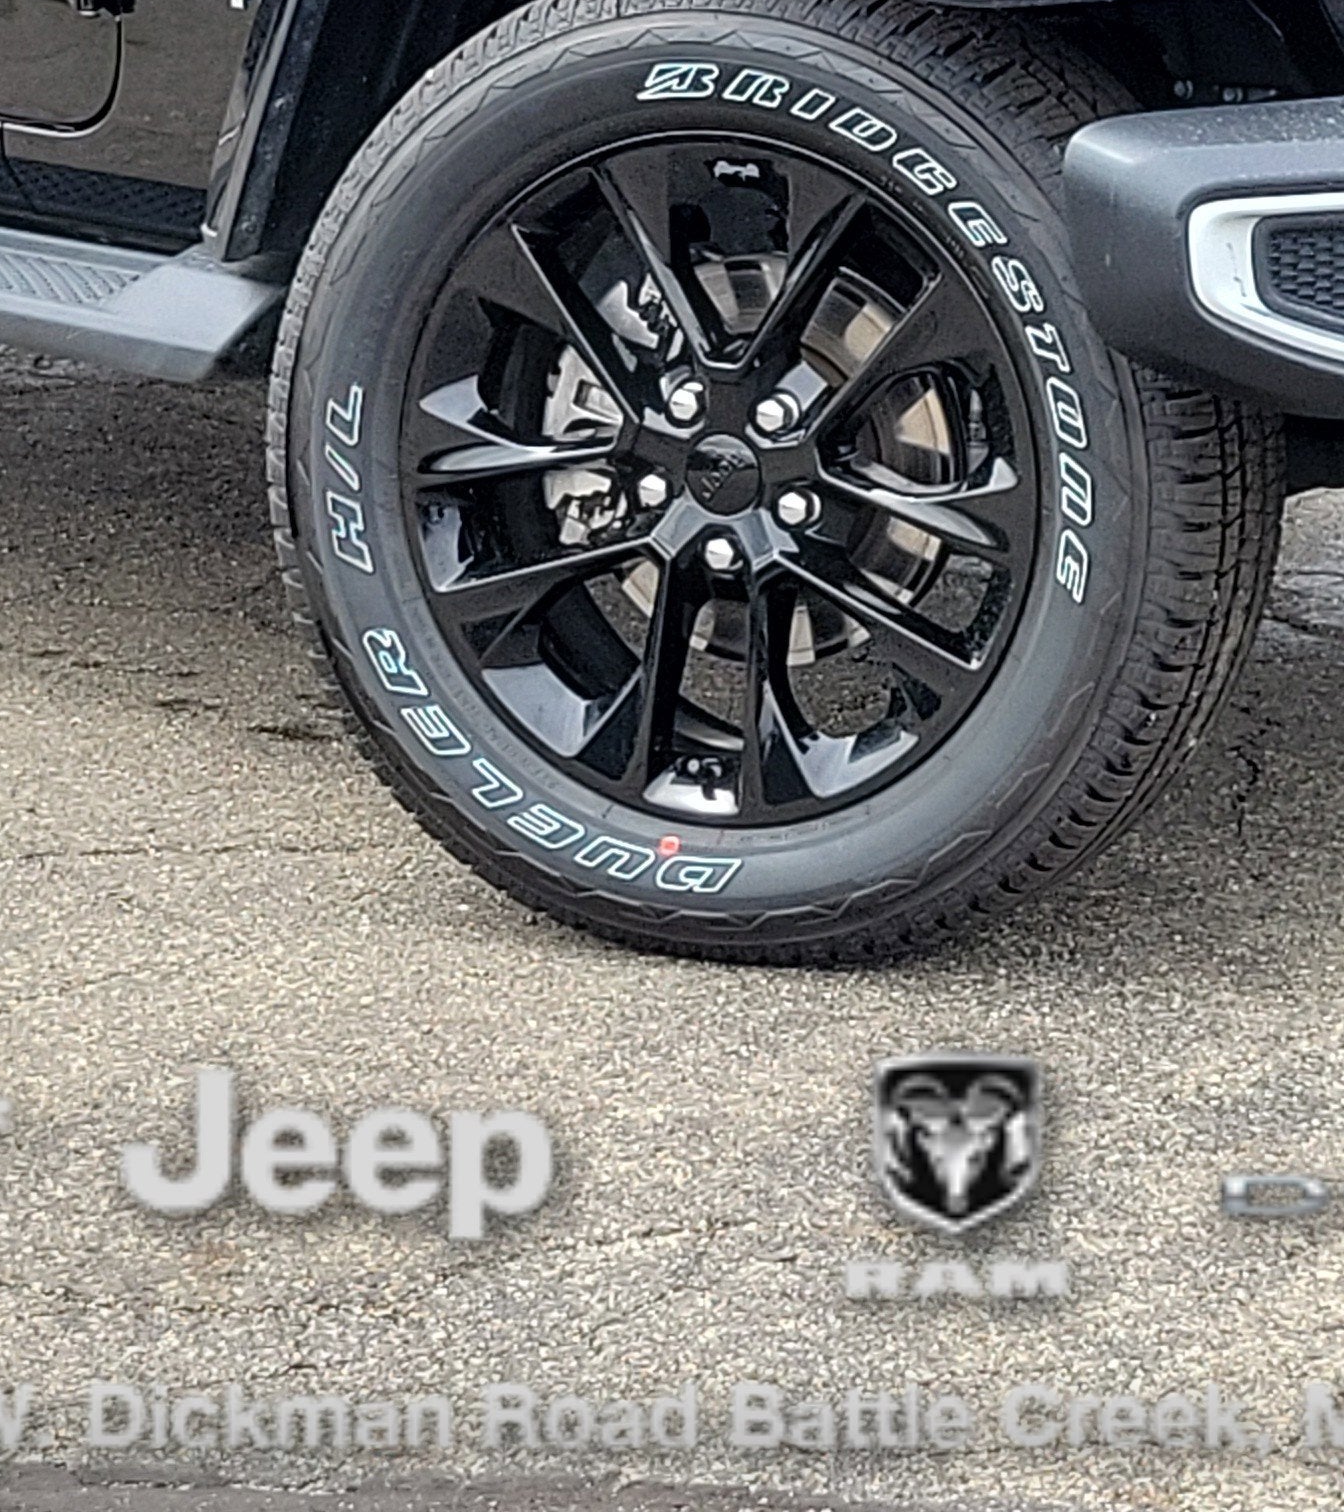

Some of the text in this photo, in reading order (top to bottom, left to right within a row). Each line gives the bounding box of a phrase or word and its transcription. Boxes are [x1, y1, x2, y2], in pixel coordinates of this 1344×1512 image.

[636, 61, 1094, 604] BRIDGESTONE
[324, 383, 744, 896] DUELER H/L
